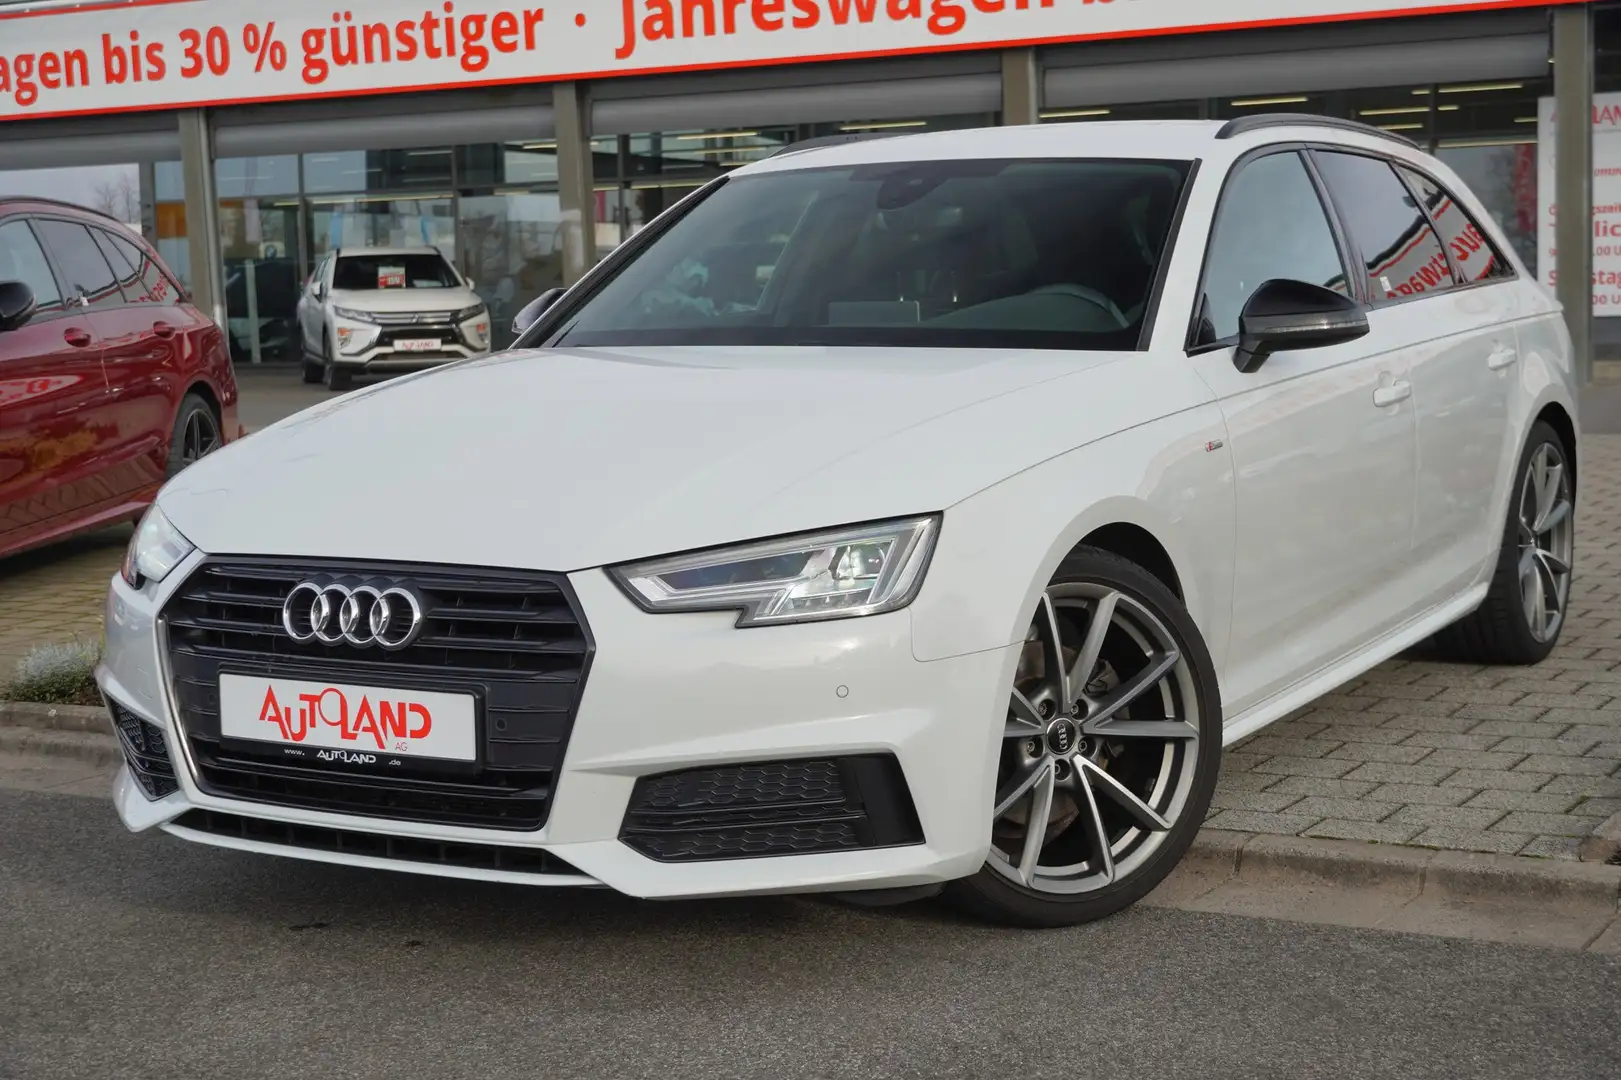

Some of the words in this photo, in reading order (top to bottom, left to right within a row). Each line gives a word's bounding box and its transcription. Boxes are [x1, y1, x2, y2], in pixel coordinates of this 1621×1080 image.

[102, 30, 166, 85] bis
[178, 25, 231, 79] 30
[242, 21, 287, 73] %
[301, 1, 545, 85] günstiger
[614, 0, 1055, 60] Jahreswg
[259, 684, 432, 750] AUTOLAND
[284, 748, 305, 756] www.
[317, 749, 376, 764] AUTOLAND
[395, 742, 408, 752] AG
